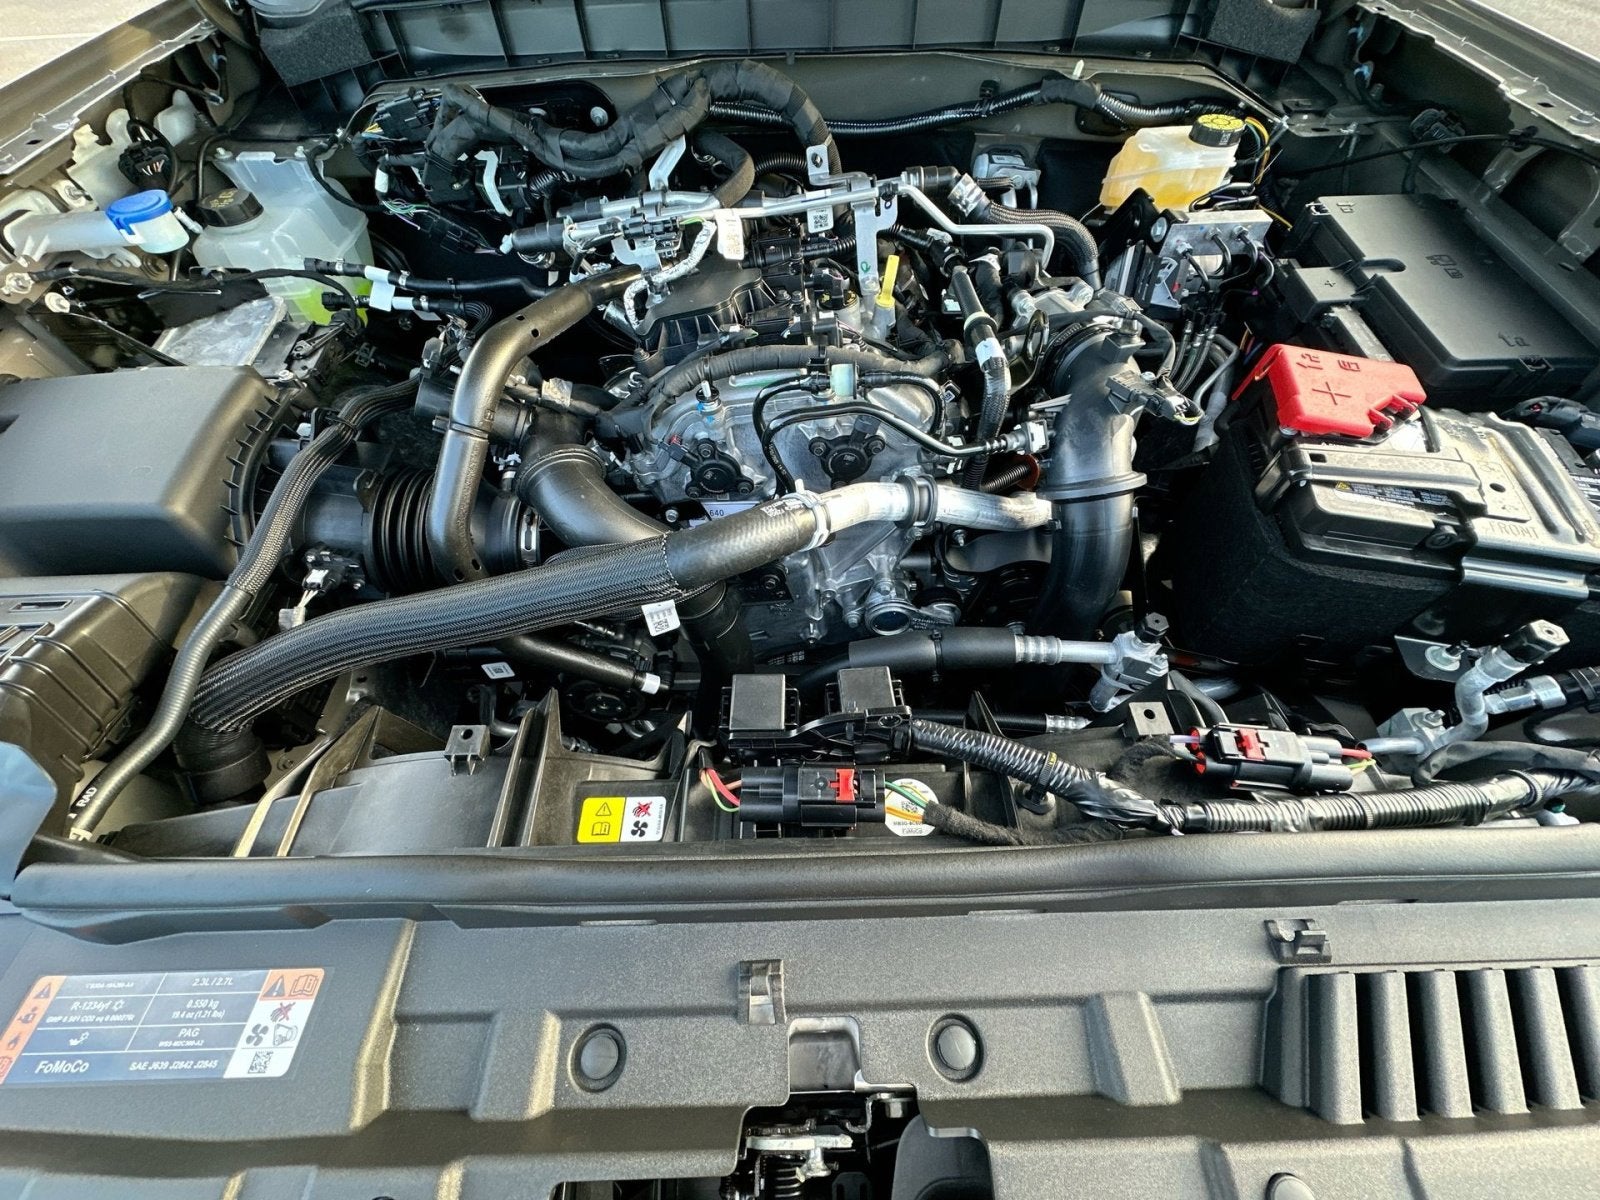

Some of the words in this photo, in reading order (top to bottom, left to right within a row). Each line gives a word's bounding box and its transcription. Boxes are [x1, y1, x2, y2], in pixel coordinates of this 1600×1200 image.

[1489, 521, 1539, 539] FRONT
[75, 786, 98, 808] RAD
[192, 978, 210, 986] 2.3L
[216, 977, 234, 986] 2.7L
[70, 1000, 112, 1012] R-1234yf
[208, 1000, 220, 1010] kg
[178, 1028, 200, 1037] PAG
[35, 1059, 90, 1075] FoMoCo
[129, 1061, 147, 1071] SAE
[148, 1060, 168, 1071] J639
